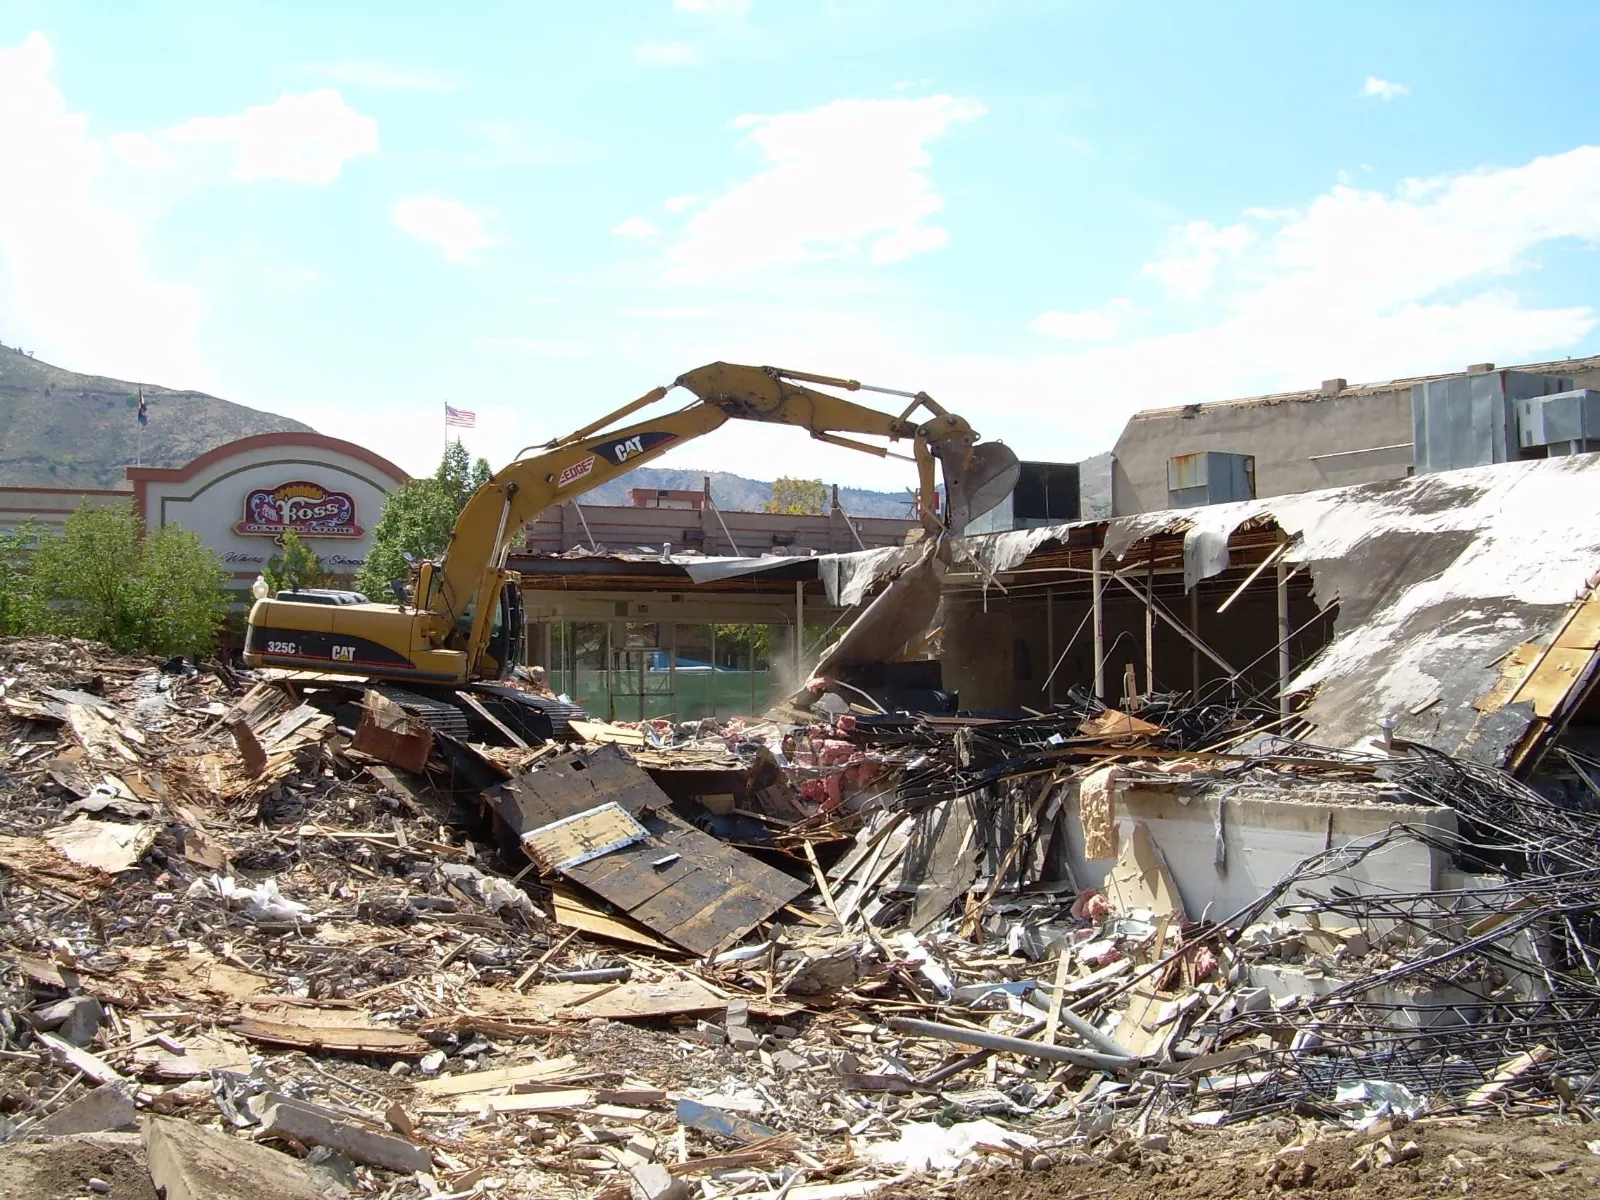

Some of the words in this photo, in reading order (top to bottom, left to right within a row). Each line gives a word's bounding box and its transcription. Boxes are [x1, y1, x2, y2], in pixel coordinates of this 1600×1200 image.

[614, 435, 644, 462] CAT
[563, 461, 590, 481] EDGE
[310, 526, 354, 534] STORE
[267, 641, 296, 654] 325C
[332, 645, 356, 661] CAT
